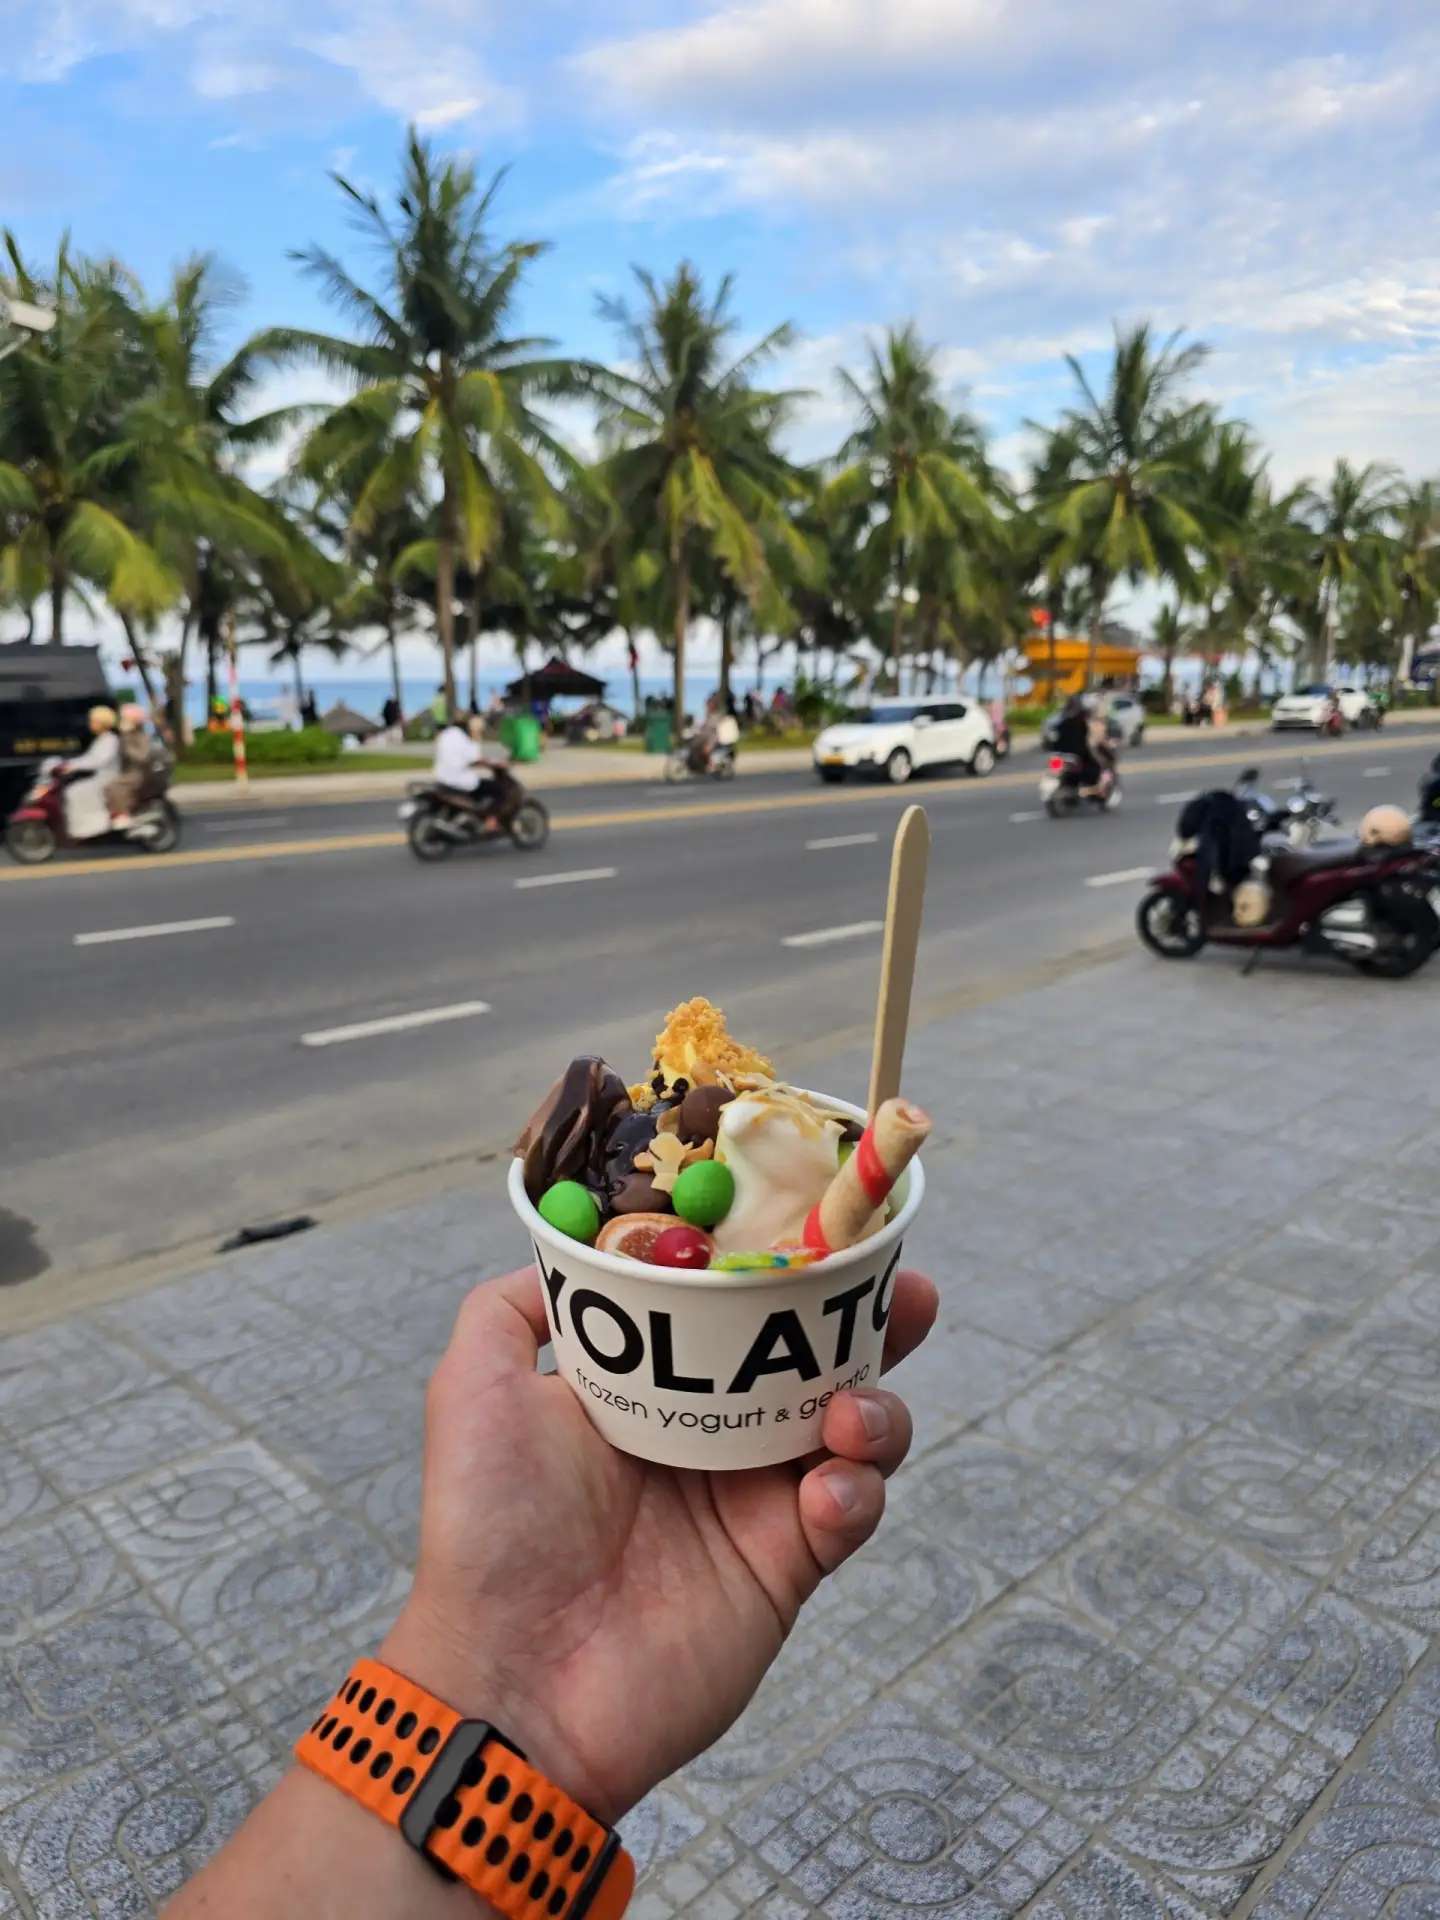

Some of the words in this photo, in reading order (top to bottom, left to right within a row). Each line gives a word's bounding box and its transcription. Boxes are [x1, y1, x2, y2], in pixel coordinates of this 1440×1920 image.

[576, 1367, 649, 1419] frozen
[656, 1406, 767, 1434] yogurt
[774, 1407, 791, 1423] &
